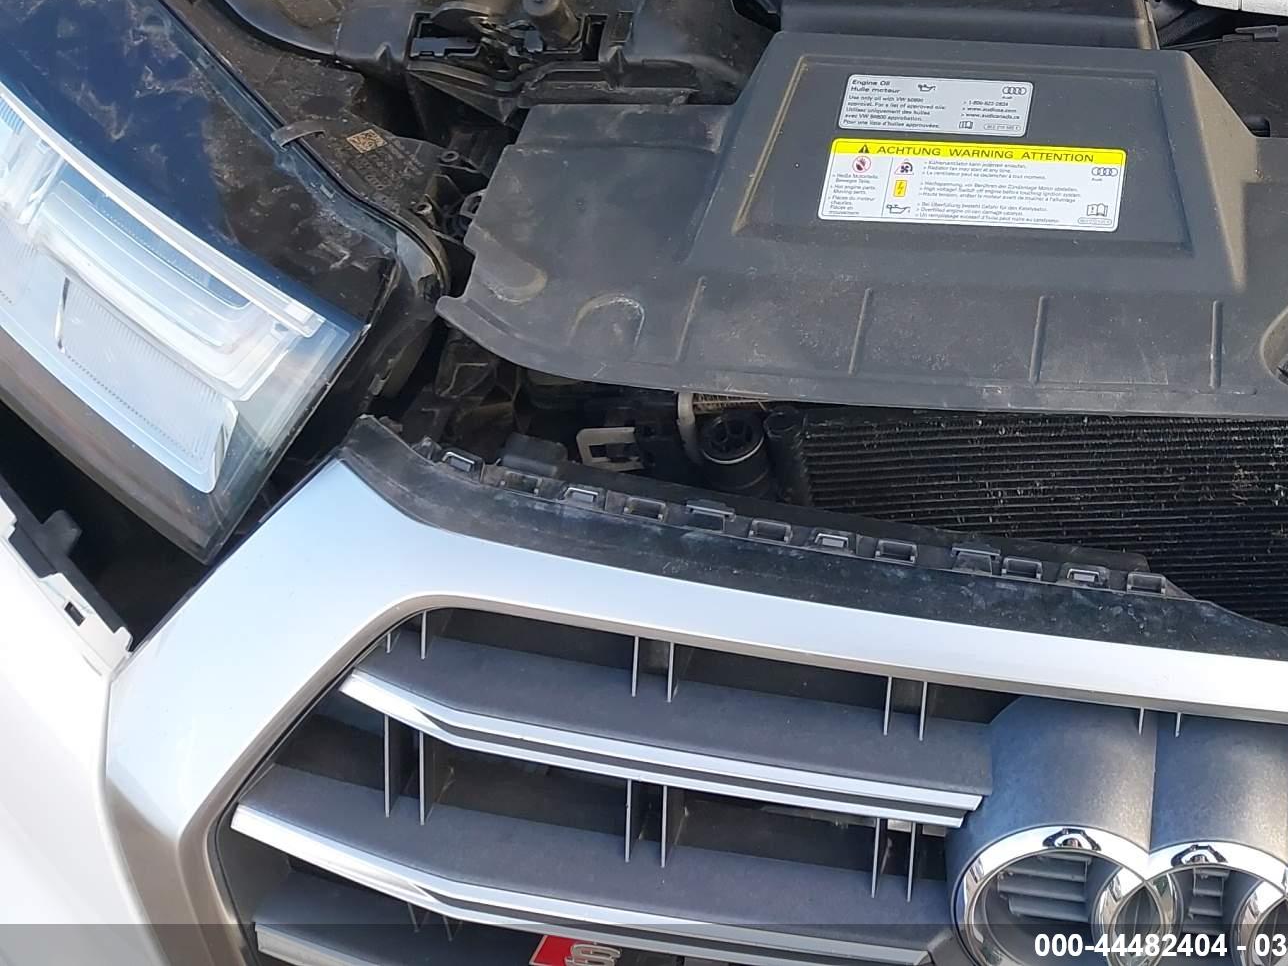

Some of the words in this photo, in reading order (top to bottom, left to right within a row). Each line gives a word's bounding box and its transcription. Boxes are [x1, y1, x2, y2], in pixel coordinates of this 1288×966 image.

[852, 79, 878, 87] Engine
[876, 145, 941, 157] ACHTUNG
[949, 148, 1014, 160] WARNING
[1020, 150, 1094, 163] ATTENTION
